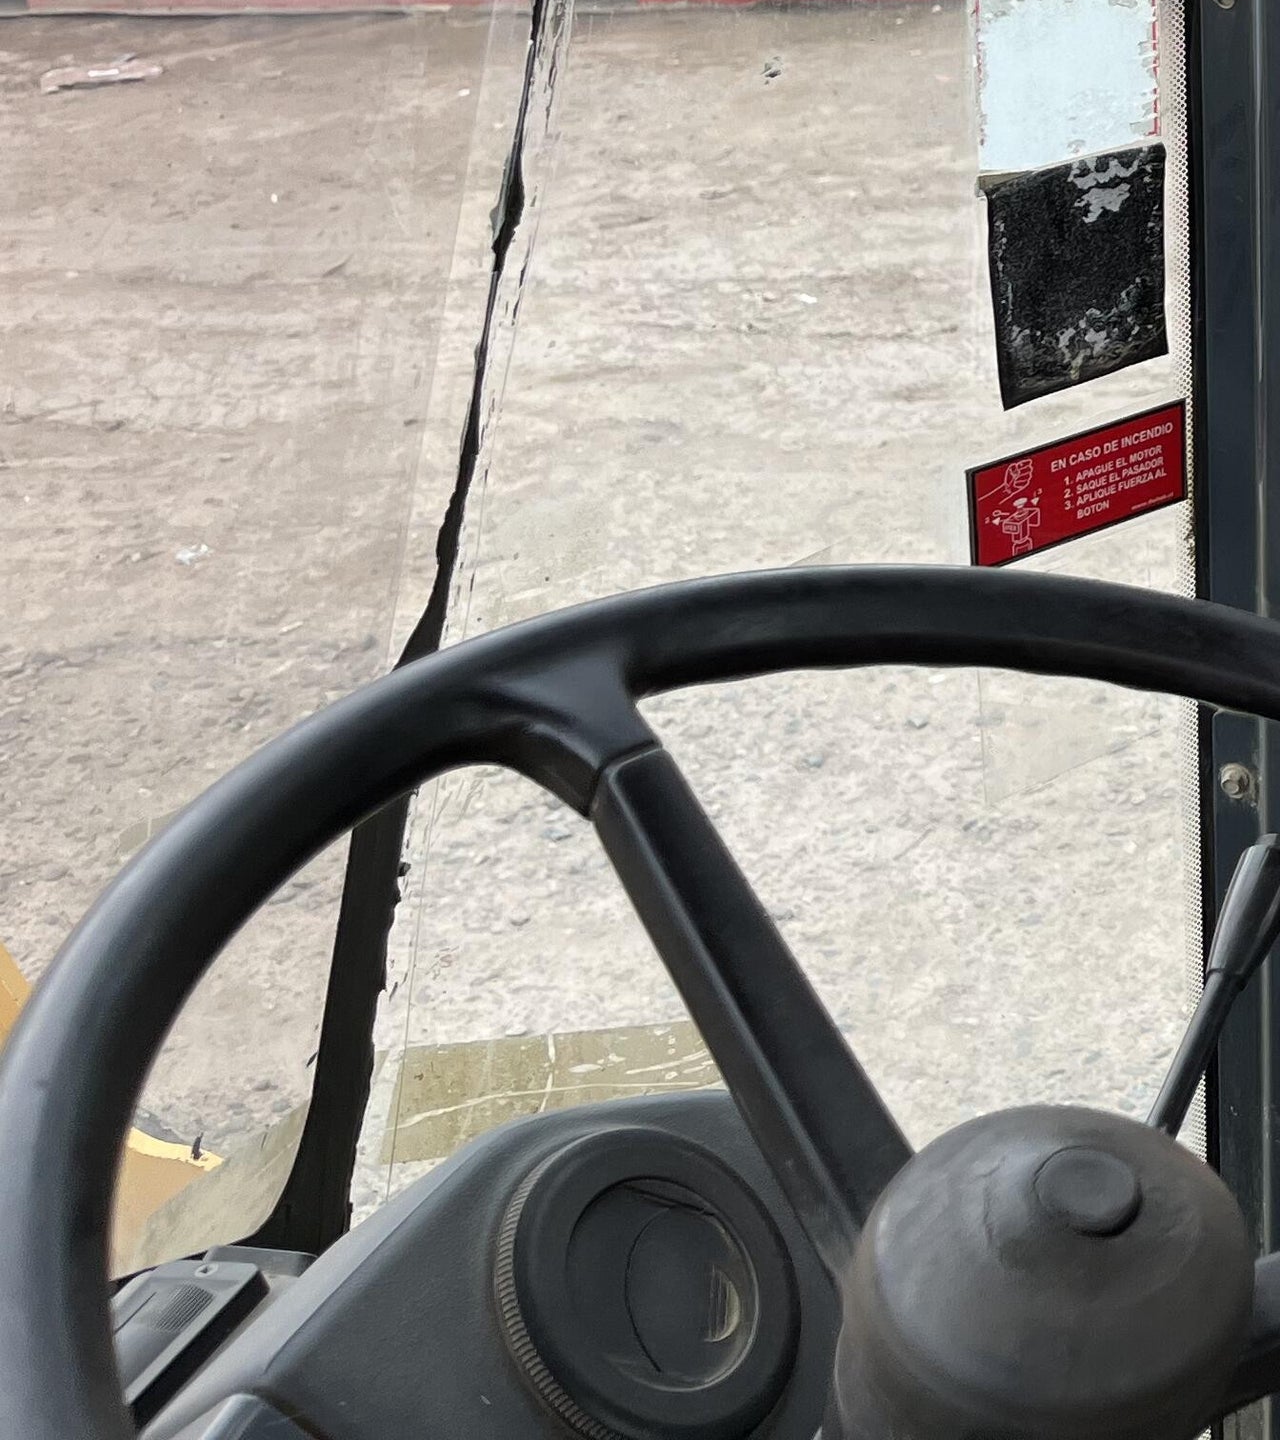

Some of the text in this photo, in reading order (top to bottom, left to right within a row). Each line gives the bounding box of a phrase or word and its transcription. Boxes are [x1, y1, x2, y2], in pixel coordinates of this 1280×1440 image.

[1051, 422, 1173, 472] EN CASO DE INCENDIO
[1075, 461, 1114, 482] APAGUE
[1116, 457, 1127, 468] EL
[1129, 445, 1162, 463] MOTOR
[1064, 457, 1164, 498] 2. SAQUE EL PASADOR
[1064, 500, 1075, 510] 3.
[1076, 486, 1116, 506] APLIQUE
[1118, 473, 1153, 491] FUERZA
[1155, 467, 1167, 478] AL
[1077, 500, 1109, 519] BOTON
